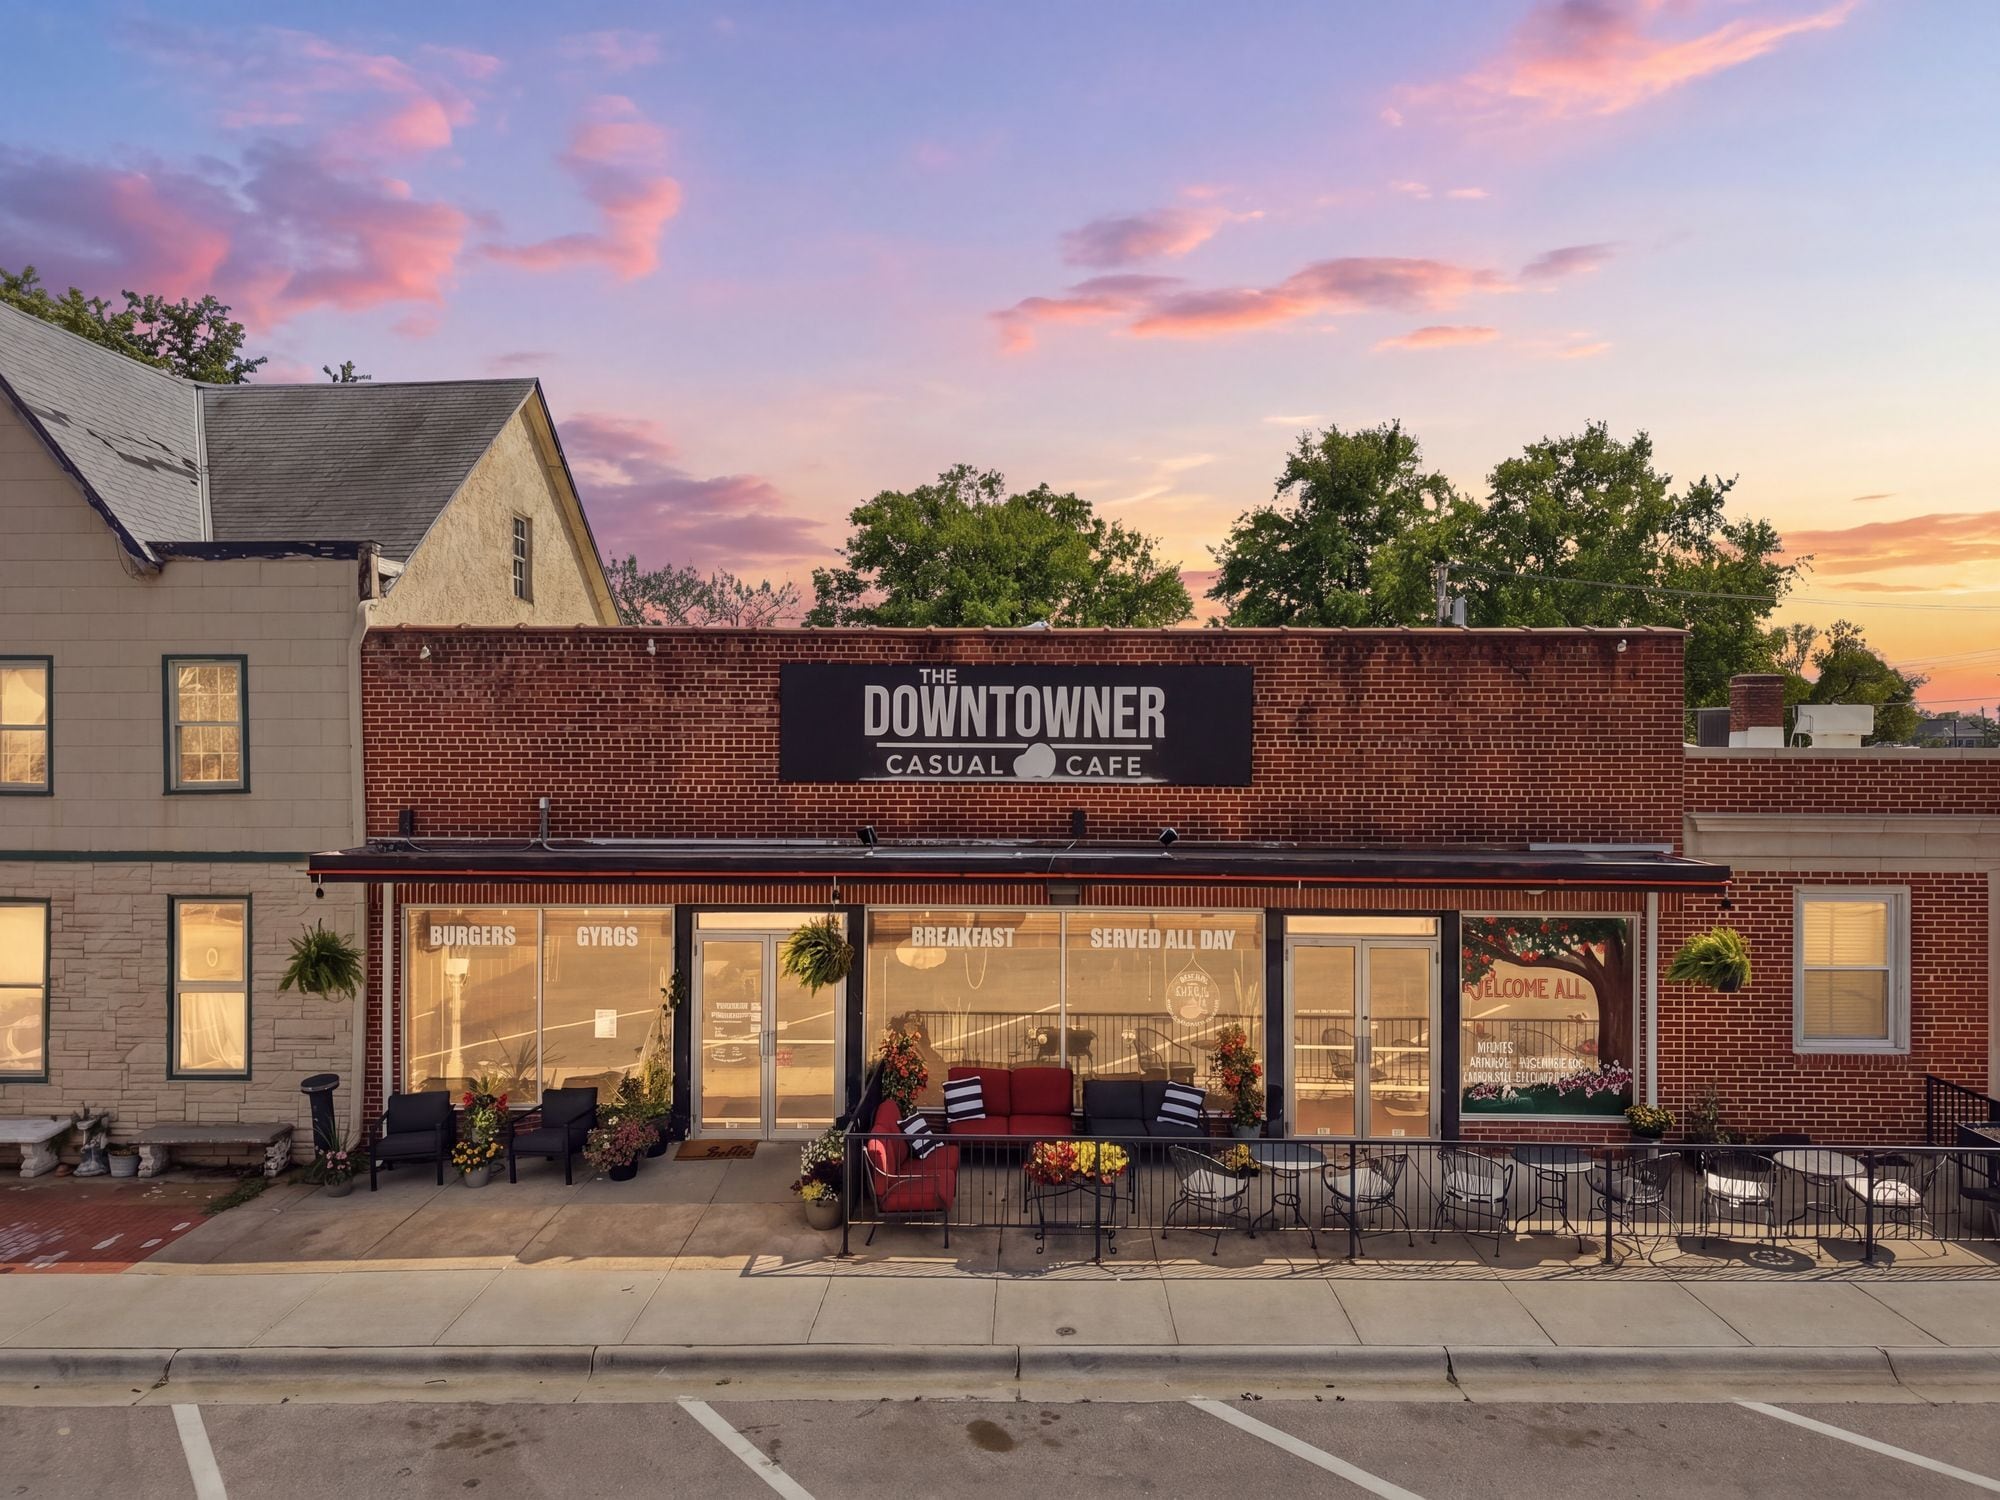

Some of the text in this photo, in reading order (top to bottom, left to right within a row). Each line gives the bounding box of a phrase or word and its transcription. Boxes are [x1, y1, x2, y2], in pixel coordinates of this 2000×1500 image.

[919, 668, 957, 685] THE
[863, 685, 1166, 739] DOWNTOWNER
[886, 754, 1142, 777] CASUAL CAFE
[430, 925, 517, 947] BURGERS
[911, 926, 1016, 948] BREAKFAST
[1090, 927, 1236, 951] SERVED ALL DAY
[1554, 978, 1587, 1000] ALL
